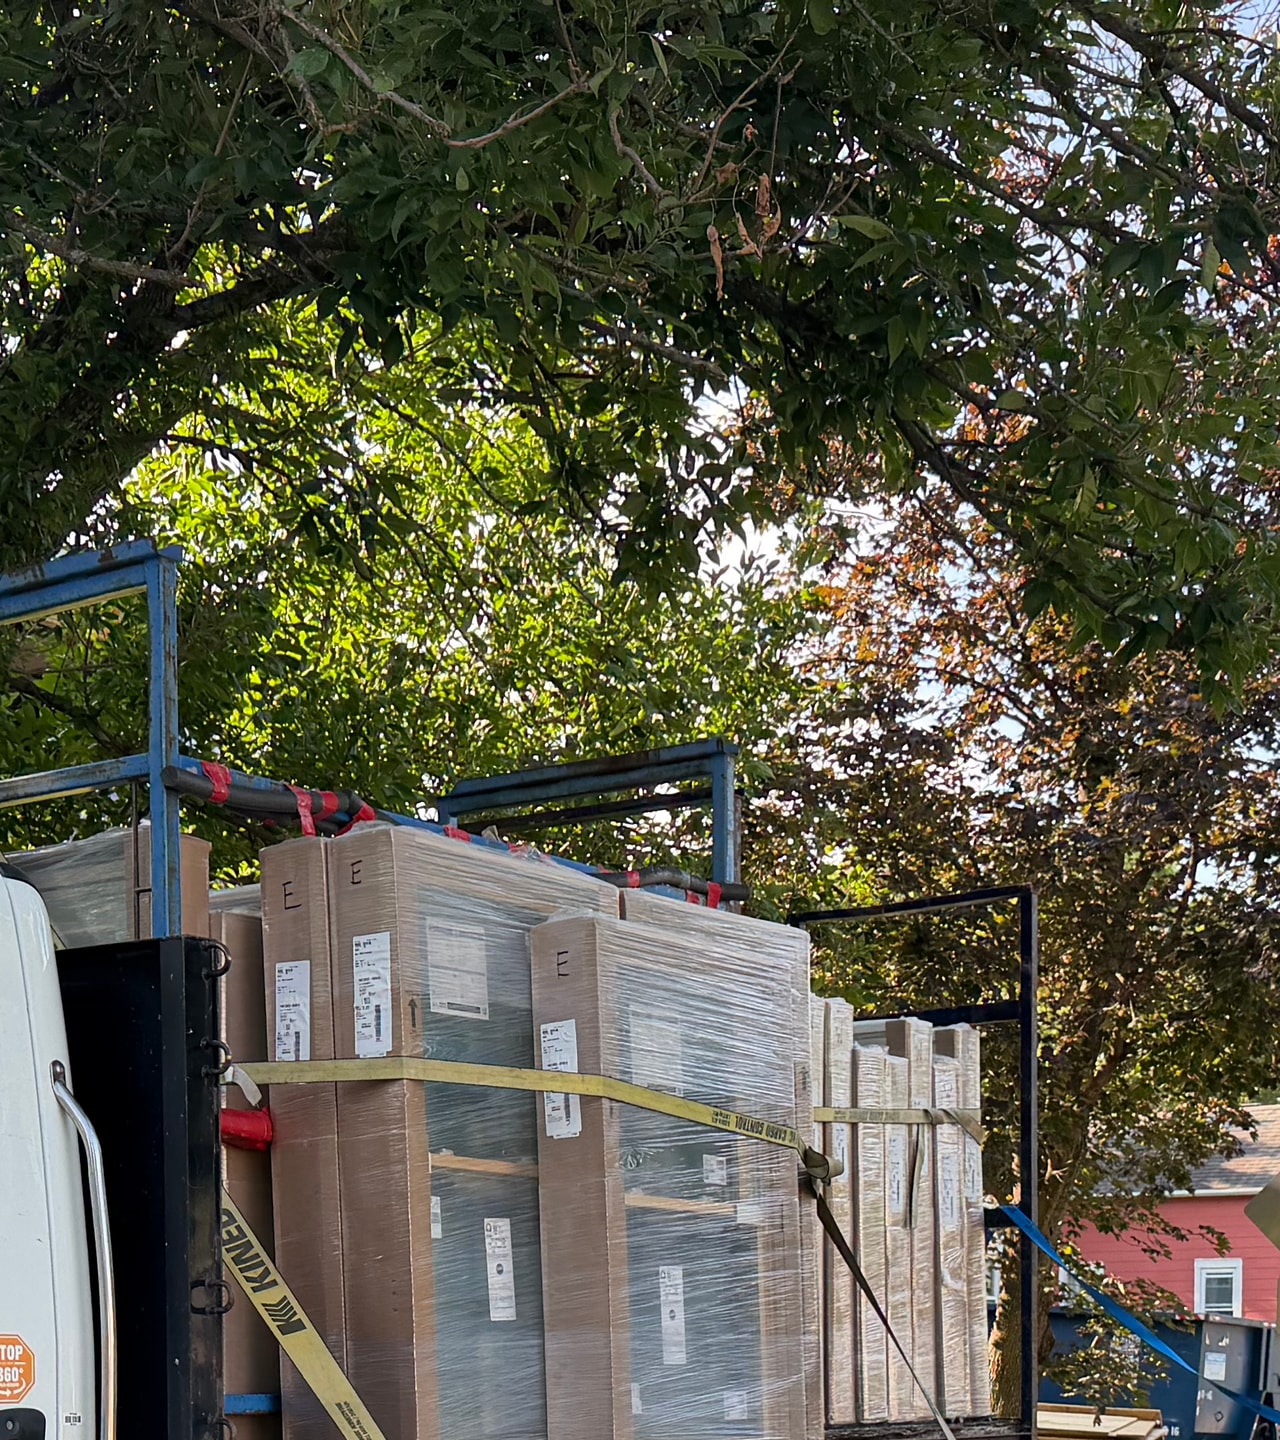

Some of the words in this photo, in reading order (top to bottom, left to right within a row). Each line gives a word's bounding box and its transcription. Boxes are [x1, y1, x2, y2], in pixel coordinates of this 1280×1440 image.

[350, 860, 363, 885] E
[281, 880, 302, 910] E
[556, 950, 569, 979] E
